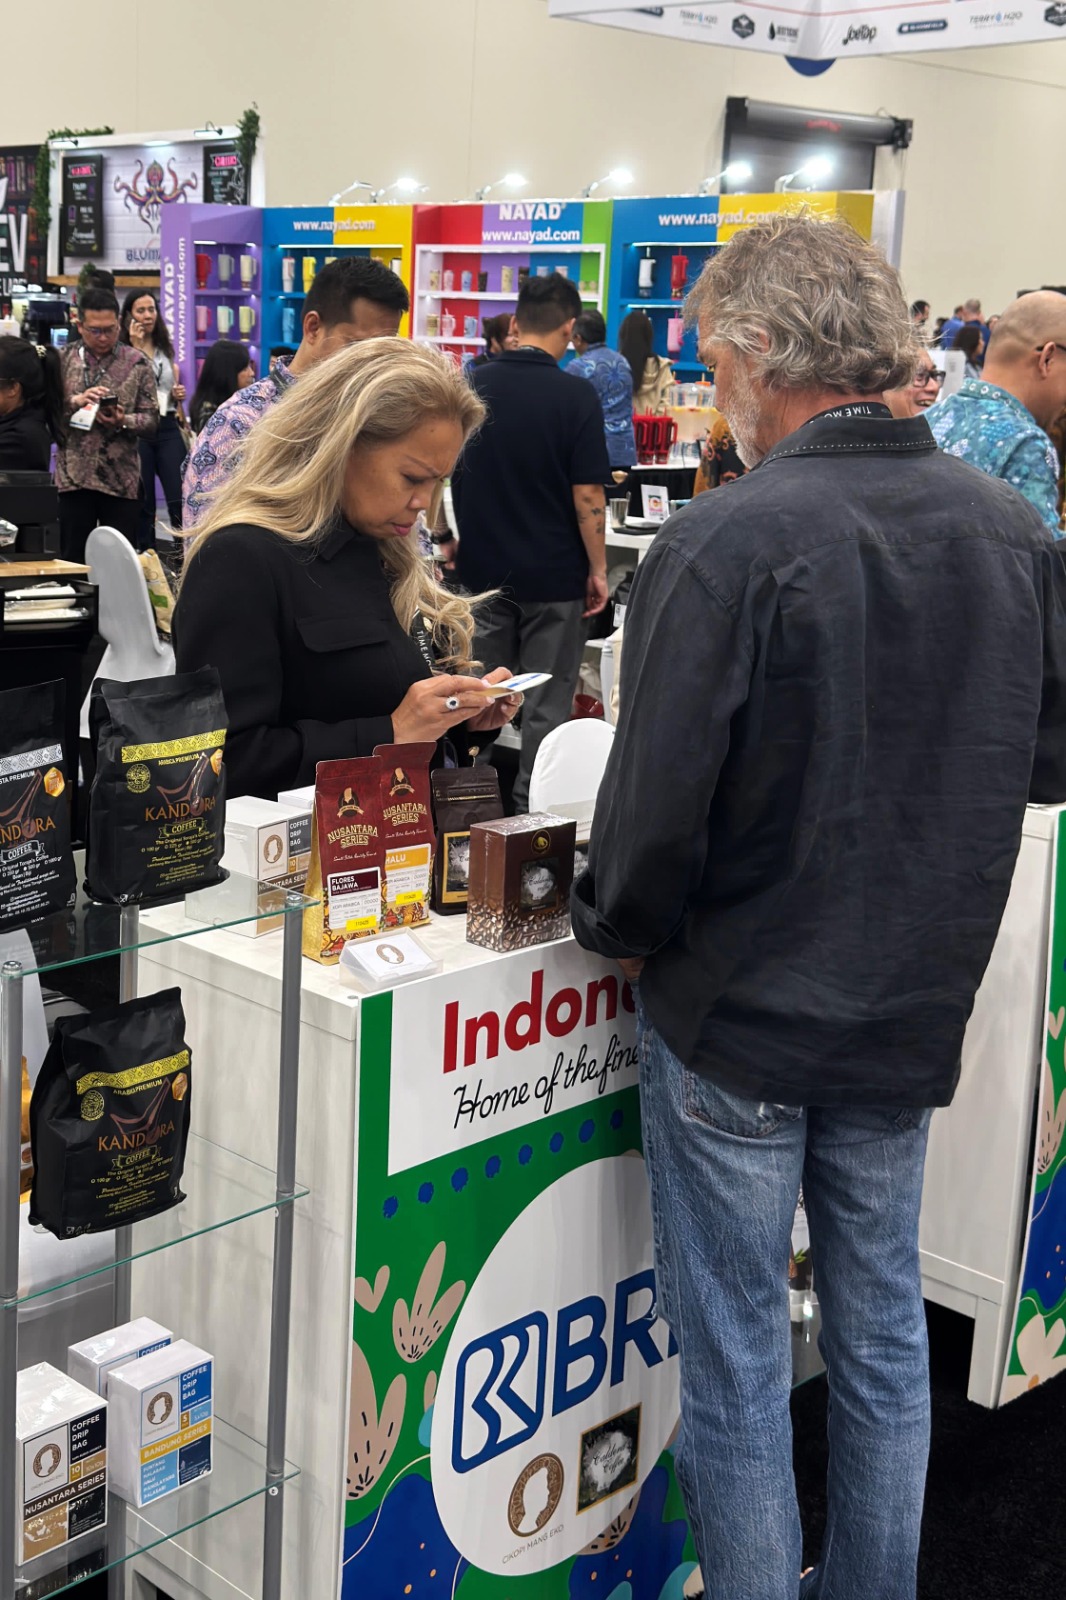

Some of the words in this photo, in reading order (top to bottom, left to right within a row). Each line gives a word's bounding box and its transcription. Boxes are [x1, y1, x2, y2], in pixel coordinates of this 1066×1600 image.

[499, 203, 561, 221] NAYAD
[293, 217, 376, 233] www.nayad.com
[482, 227, 580, 244] www.nayad.com
[177, 238, 187, 362] www.nayad.com
[844, 405, 872, 417] TIME
[416, 630, 429, 652] TIME
[175, 753, 199, 763] PREMIUM
[9, 770, 36, 782] PREMIUM
[172, 820, 197, 834] COFFEE
[290, 819, 309, 829] COFFEE
[391, 812, 420, 827] SERIES
[0, 815, 56, 843] NDORA
[290, 829, 301, 838] DRIP
[327, 824, 379, 844] NUSANTARA
[290, 839, 300, 847] BAG
[340, 835, 370, 849] SERIES
[8, 843, 32, 860] COFFEE
[332, 876, 355, 885] FLORES
[332, 882, 358, 891] BAJAWA
[135, 1079, 163, 1091] PREMIUM
[453, 1078, 530, 1129] Home
[534, 1051, 564, 1115] of
[564, 1043, 600, 1090] the
[126, 1149, 150, 1165] COFFEE
[552, 1268, 679, 1417] BR
[182, 1365, 208, 1381] COFFEE
[182, 1378, 197, 1391] DRIP
[182, 1389, 196, 1400] BAG
[72, 1414, 100, 1432] COFFEE
[72, 1429, 89, 1442] DRIP
[144, 1435, 182, 1458] BANDUNG
[183, 1424, 208, 1441] SERIES
[72, 1440, 88, 1451] BAG
[72, 1465, 80, 1475] 10
[25, 1486, 76, 1516] NUSANTARA
[78, 1472, 105, 1491] SERIES
[502, 1544, 526, 1564] CIKOPI
[526, 1532, 549, 1551] MANG
[549, 1524, 565, 1538] EKO
